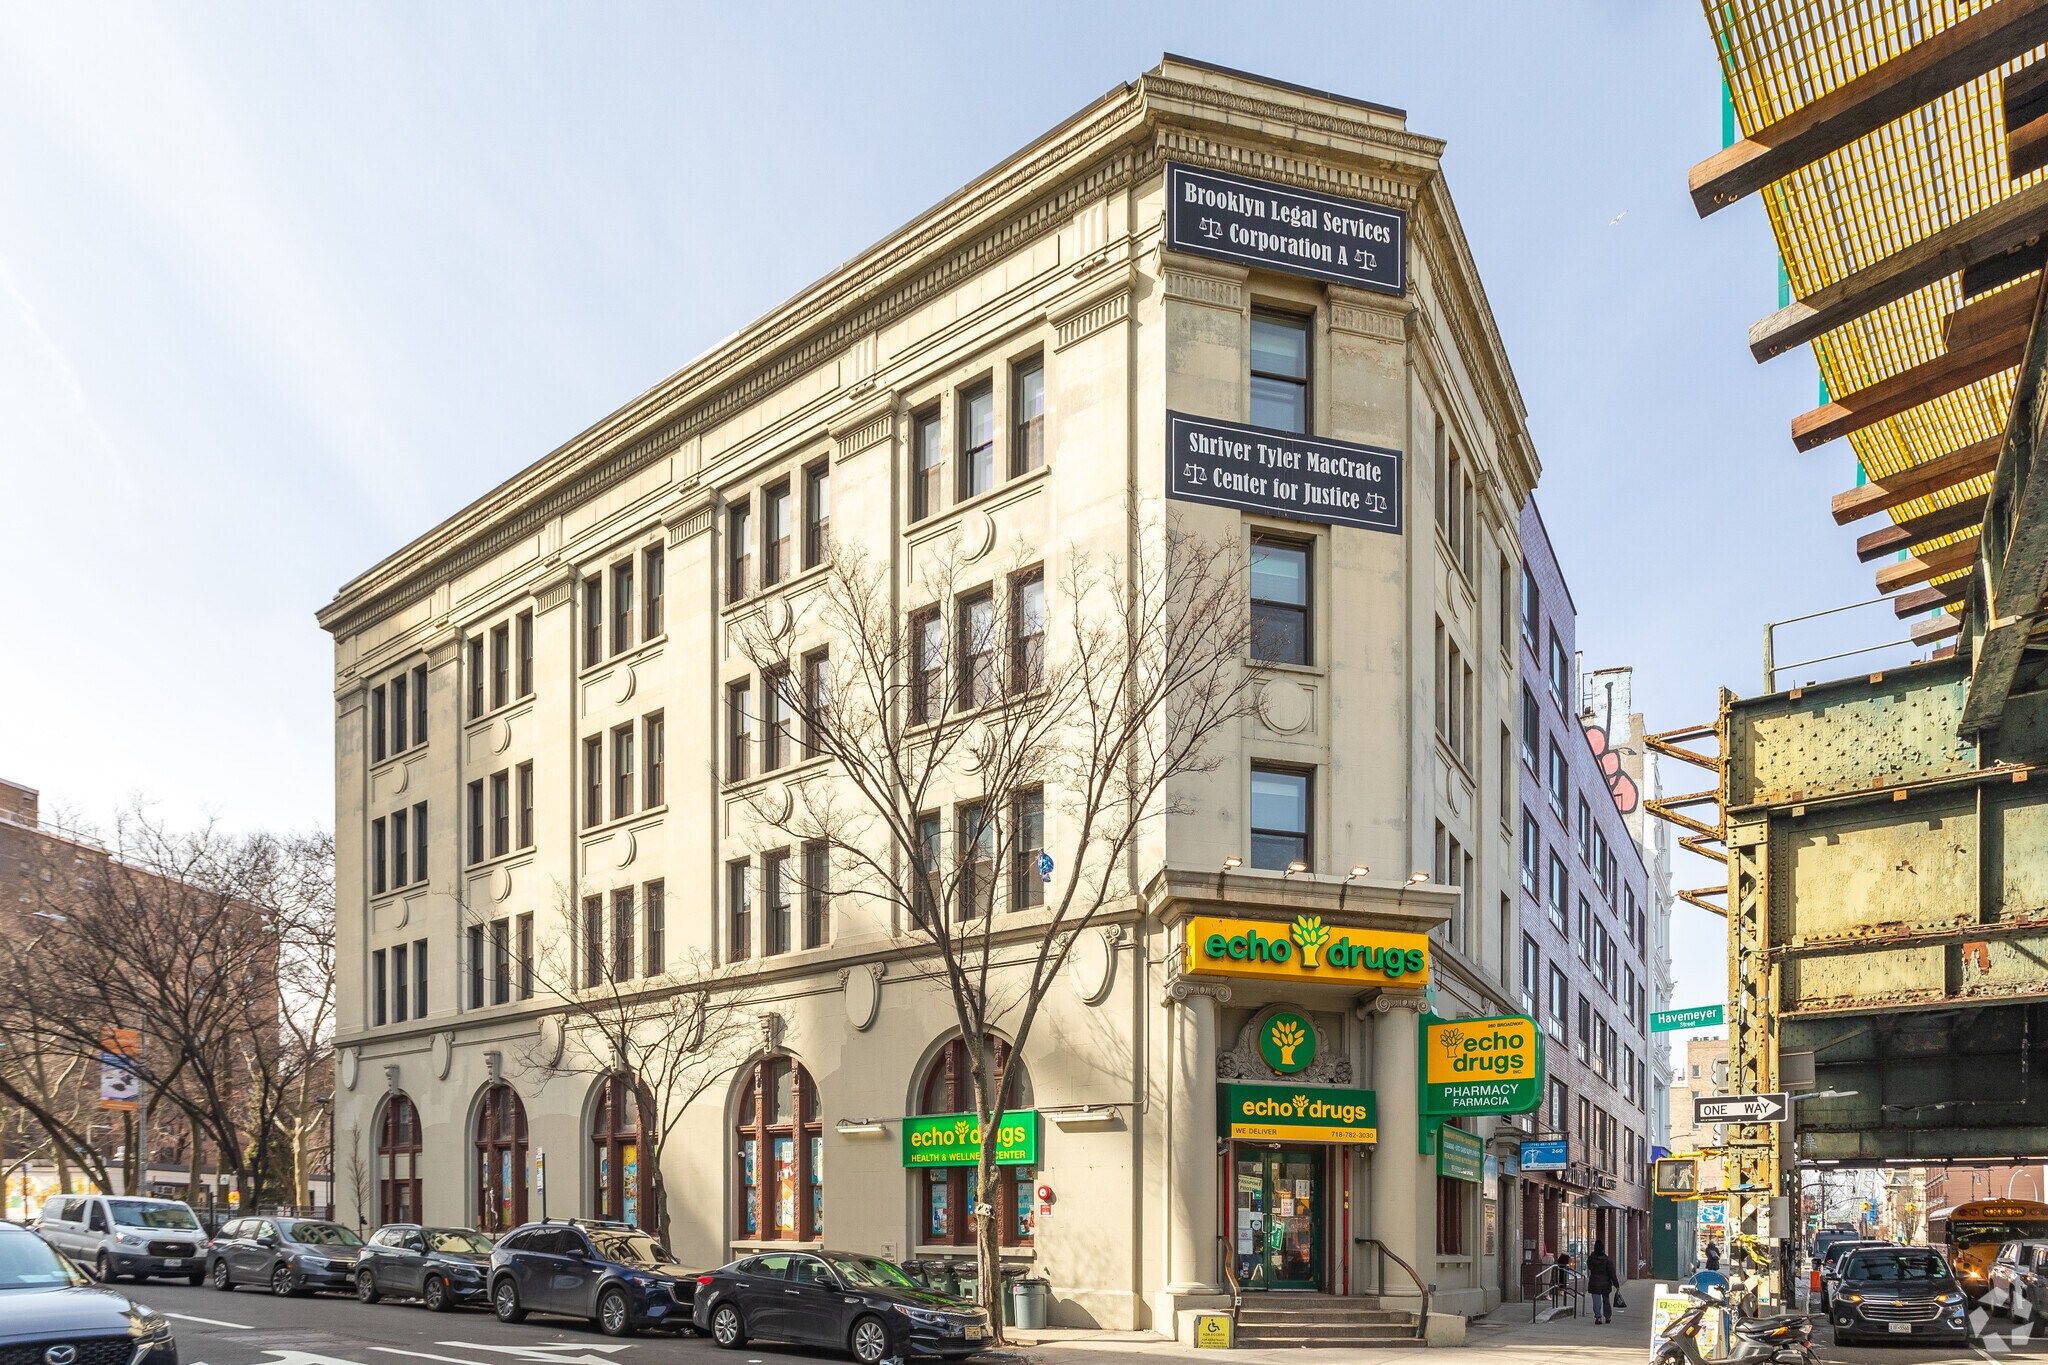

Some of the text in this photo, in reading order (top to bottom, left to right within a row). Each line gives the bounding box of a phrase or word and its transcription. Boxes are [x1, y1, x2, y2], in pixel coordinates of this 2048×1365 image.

[1184, 181, 1391, 244] Brooklyn Legal Services
[1229, 223, 1349, 266] Corporation A
[1189, 431, 1382, 483] Shriver Tyler MacCrate
[1213, 467, 1360, 510] Center for Justice
[1204, 929, 1425, 978] echo drugs
[1657, 1008, 1717, 1024] Havemeyer
[1463, 1031, 1524, 1052] echo
[1453, 1053, 1524, 1075] drugs
[1444, 1083, 1519, 1098] PHARMACY
[1242, 1097, 1367, 1123] echo drugs
[1453, 1096, 1510, 1107] FARMACIA
[1703, 1103, 1770, 1116] ONE WAY
[911, 1125, 1026, 1148] echo dgs
[1235, 1127, 1247, 1135] WE
[1331, 1131, 1374, 1139] 718-782-3030
[911, 1153, 940, 1162] HEALTH
[949, 1152, 981, 1161] WELLNE
[995, 1150, 1026, 1159] CENTER
[1667, 1301, 1688, 1309] echo
